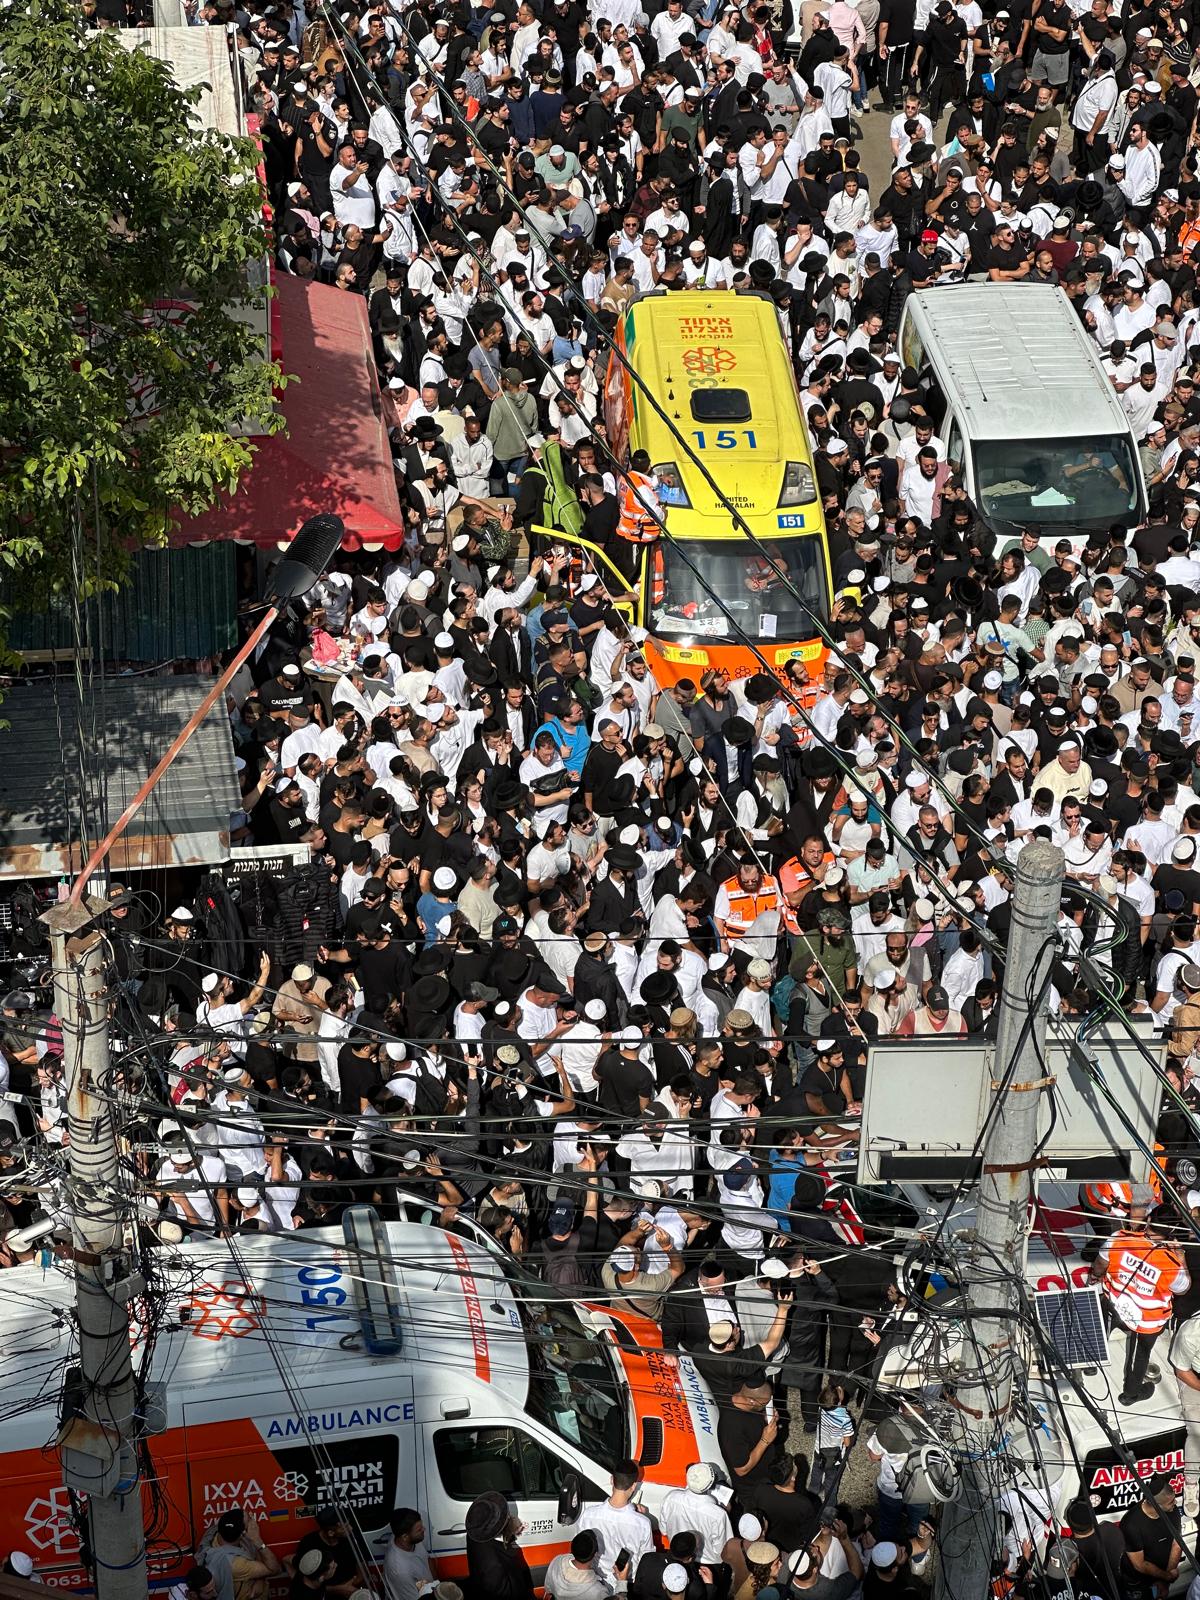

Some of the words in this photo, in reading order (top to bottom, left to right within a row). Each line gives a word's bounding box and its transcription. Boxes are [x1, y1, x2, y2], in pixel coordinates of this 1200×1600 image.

[678, 317, 731, 325] איחוד
[680, 324, 733, 333] הצלה
[691, 430, 757, 449] 151
[781, 518, 802, 527] 151
[233, 861, 260, 873] מתנות
[262, 860, 284, 871] חנות
[298, 1263, 349, 1330] 150
[681, 1359, 713, 1435] AMBULANCE
[267, 1403, 414, 1437] AMBULANCE
[315, 1461, 383, 1483] איחוד
[204, 1479, 263, 1501] ІХУД
[317, 1478, 383, 1501] הצלה
[1113, 1478, 1152, 1496] ИХУ
[203, 1497, 267, 1516] АЦАЛА
